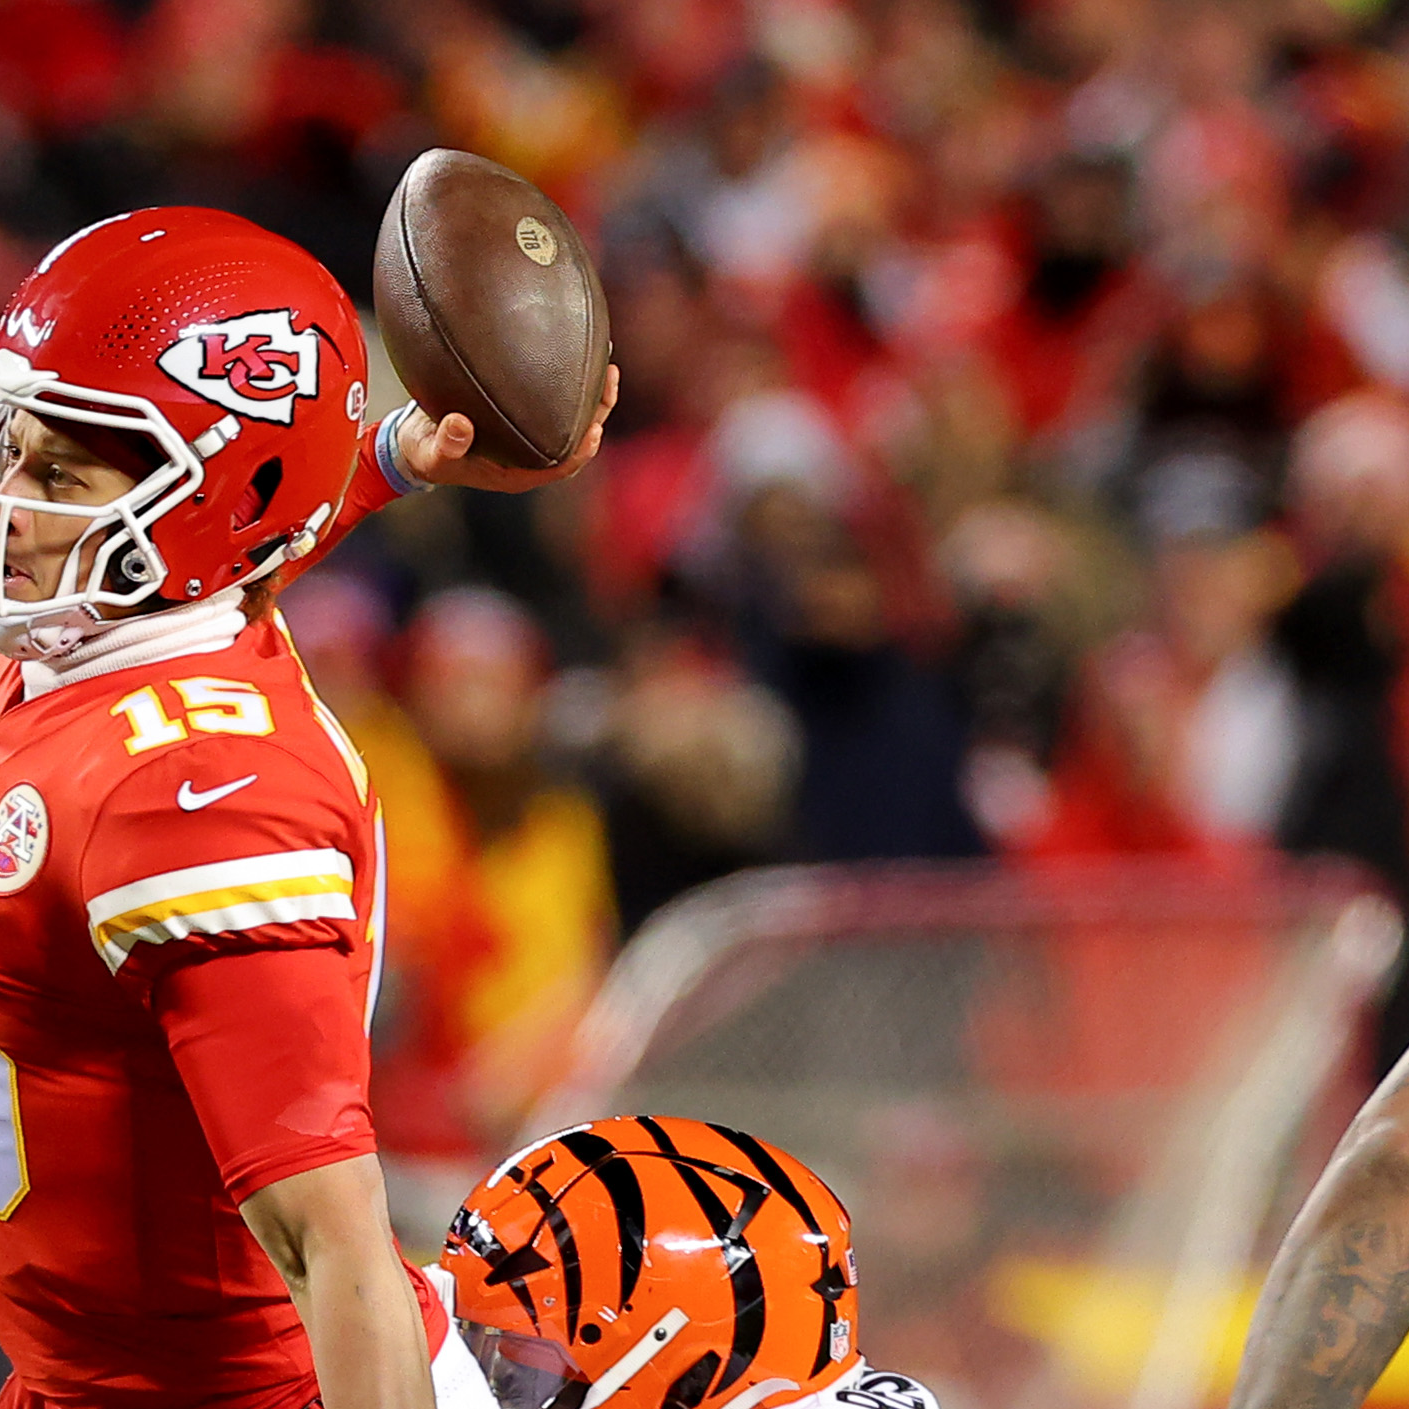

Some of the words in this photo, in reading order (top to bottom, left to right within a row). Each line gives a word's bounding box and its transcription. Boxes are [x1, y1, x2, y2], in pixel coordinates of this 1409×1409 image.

[519, 228, 541, 250] 178
[198, 334, 300, 402] KC
[109, 675, 277, 757] 15
